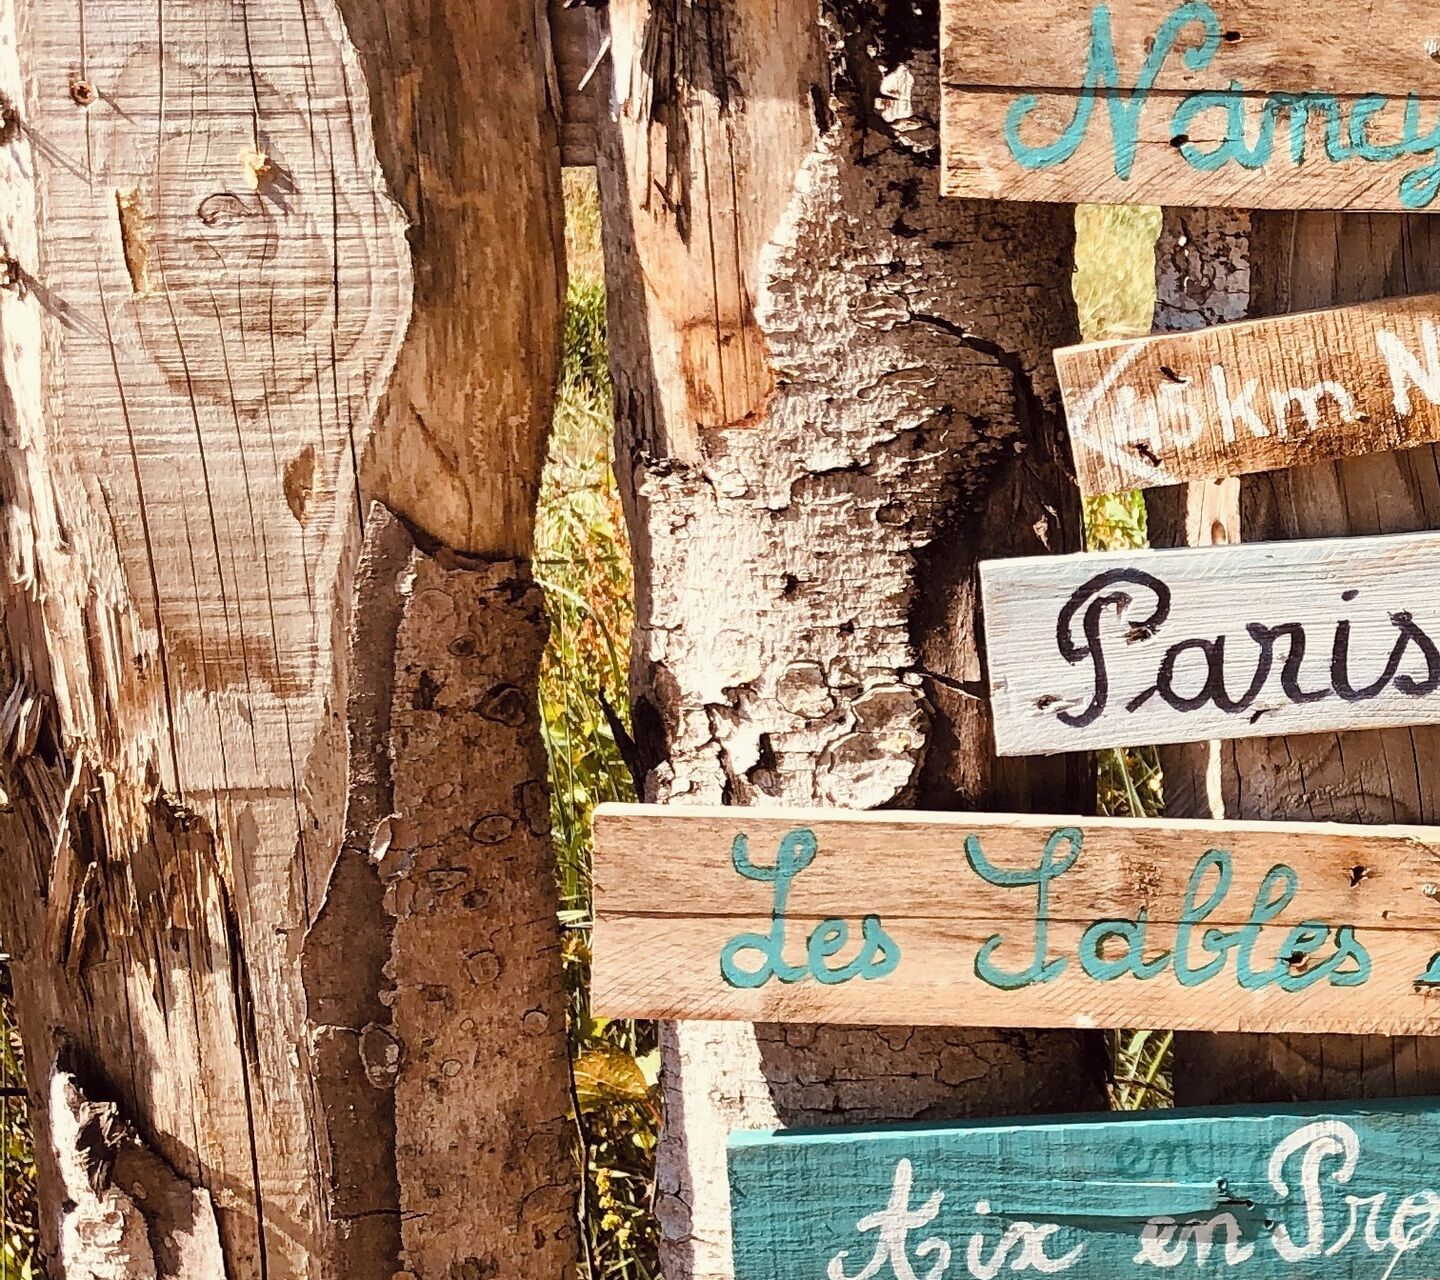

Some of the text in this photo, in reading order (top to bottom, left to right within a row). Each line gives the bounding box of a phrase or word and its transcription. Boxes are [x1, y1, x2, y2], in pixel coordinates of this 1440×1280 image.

[720, 827, 902, 988] Les
[964, 826, 1372, 992] Sables
[1132, 1212, 1254, 1267] en
